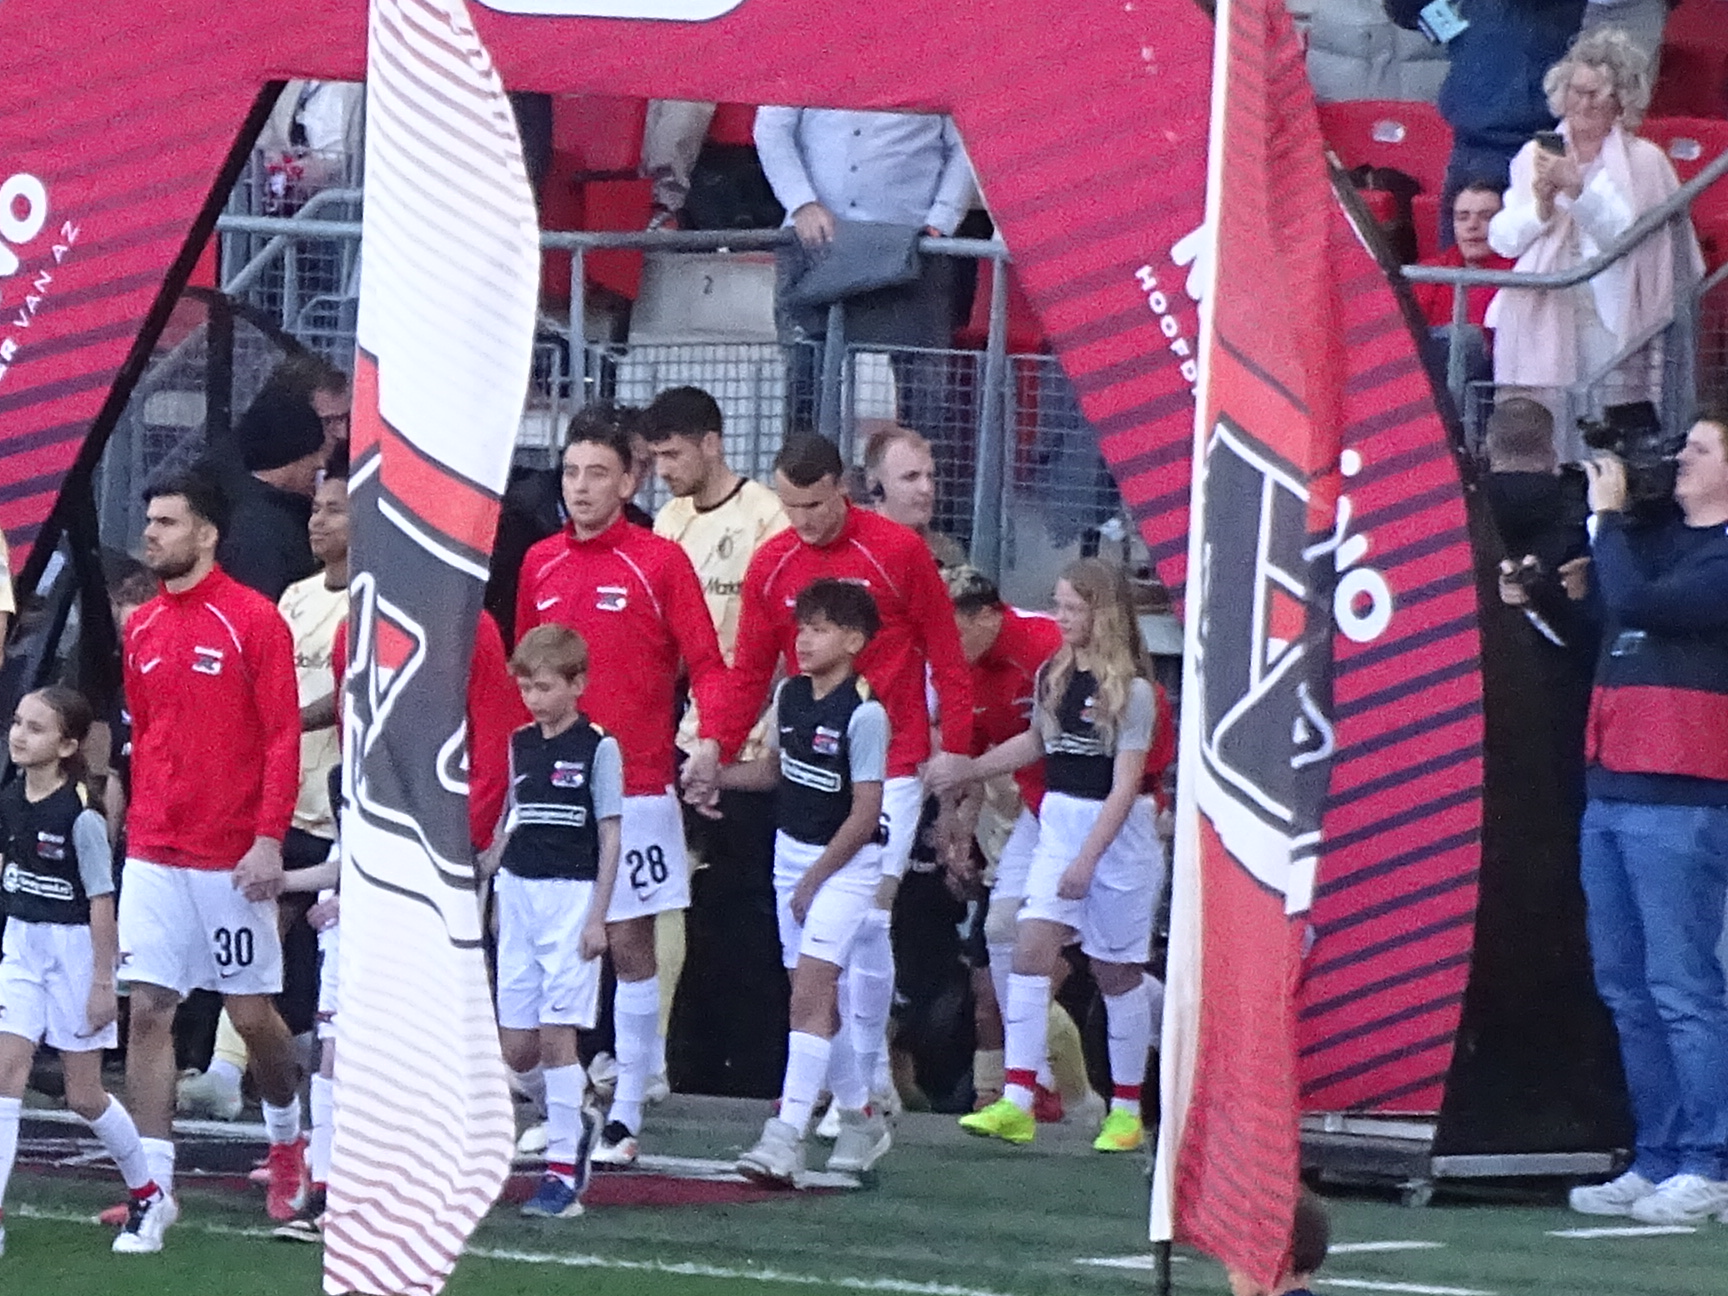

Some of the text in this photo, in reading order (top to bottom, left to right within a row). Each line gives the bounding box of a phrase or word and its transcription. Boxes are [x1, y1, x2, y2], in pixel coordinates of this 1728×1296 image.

[14, 270, 52, 329] VAN
[52, 220, 81, 264] AZ
[1134, 263, 1201, 397] HOOFD
[625, 845, 669, 889] 28
[212, 927, 254, 968] 30
